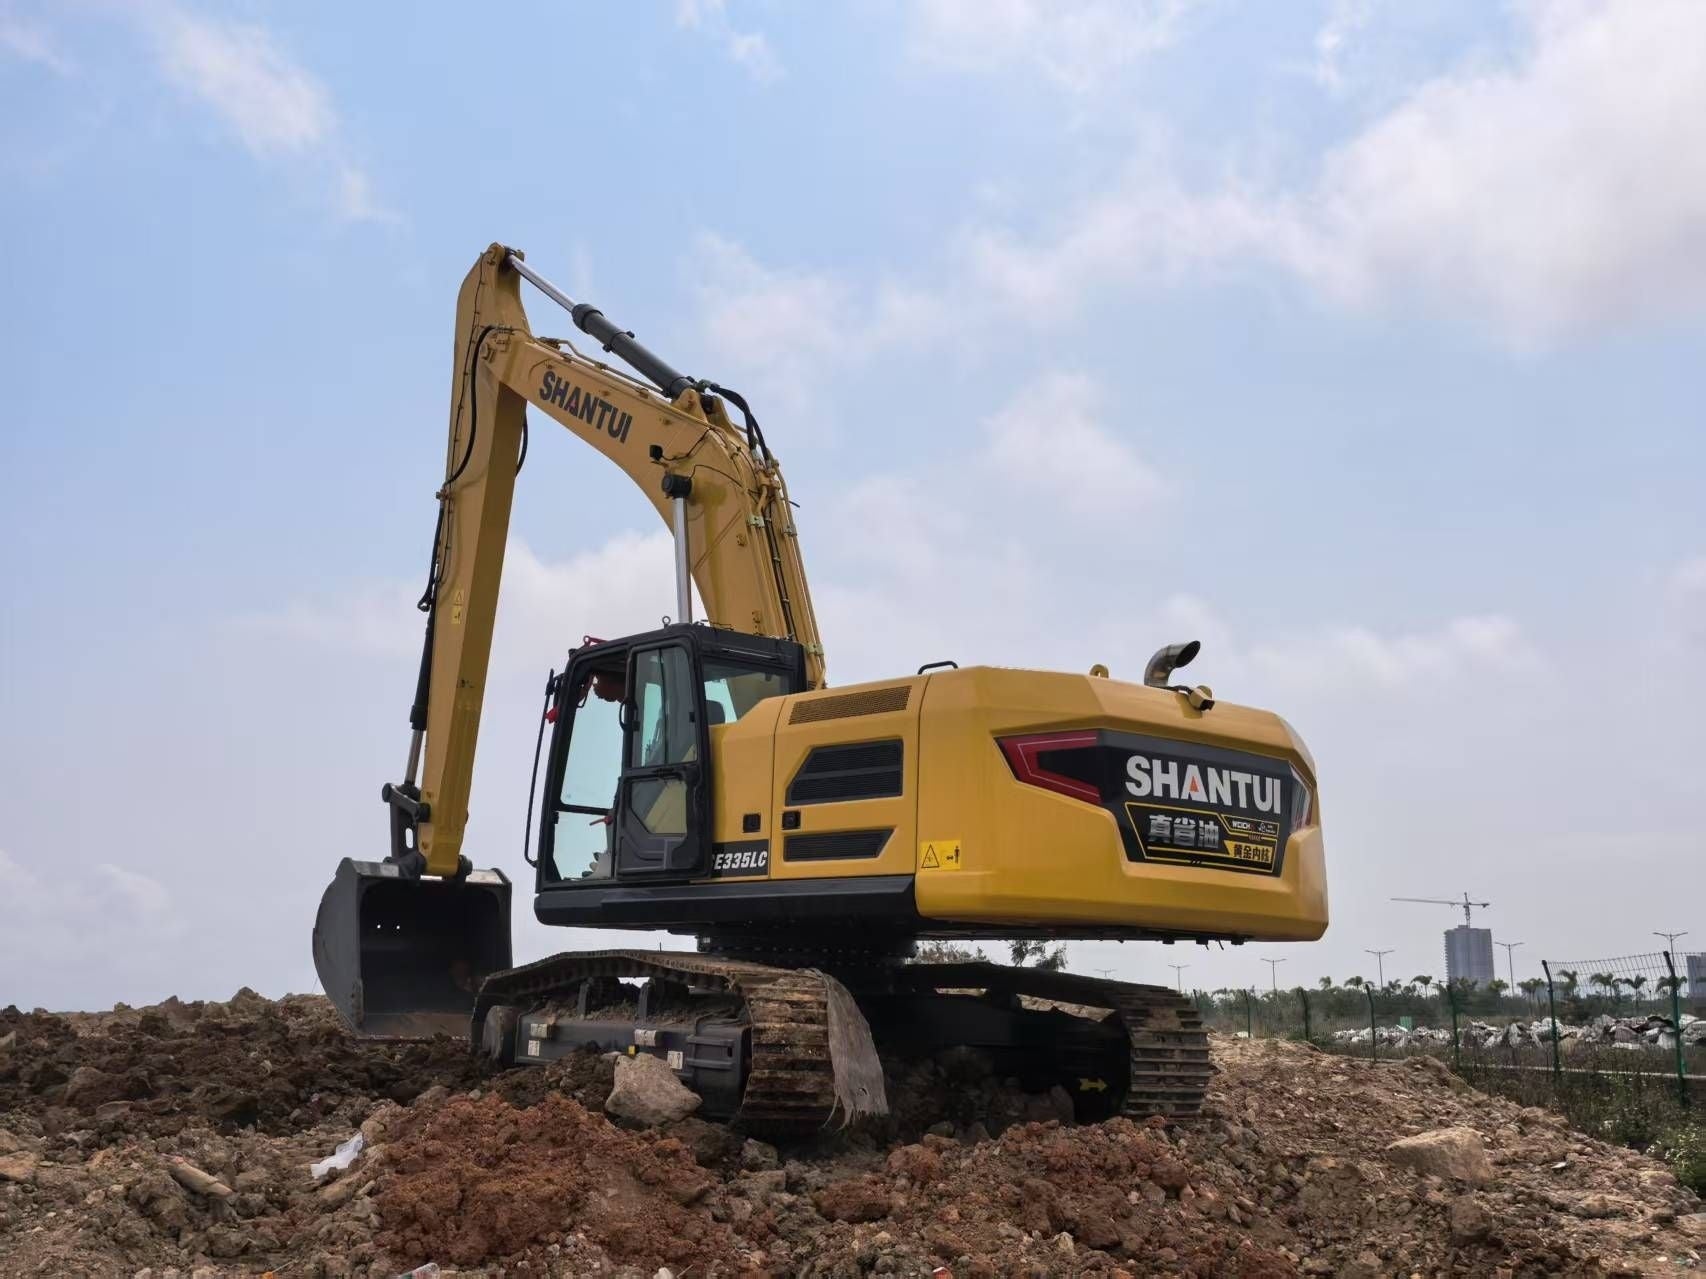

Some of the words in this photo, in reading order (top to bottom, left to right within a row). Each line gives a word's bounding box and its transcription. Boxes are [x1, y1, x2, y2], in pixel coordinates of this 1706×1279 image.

[539, 370, 633, 444] SHANTUI
[1125, 755, 1281, 814] SHANTUI
[712, 850, 768, 870] E335LC
